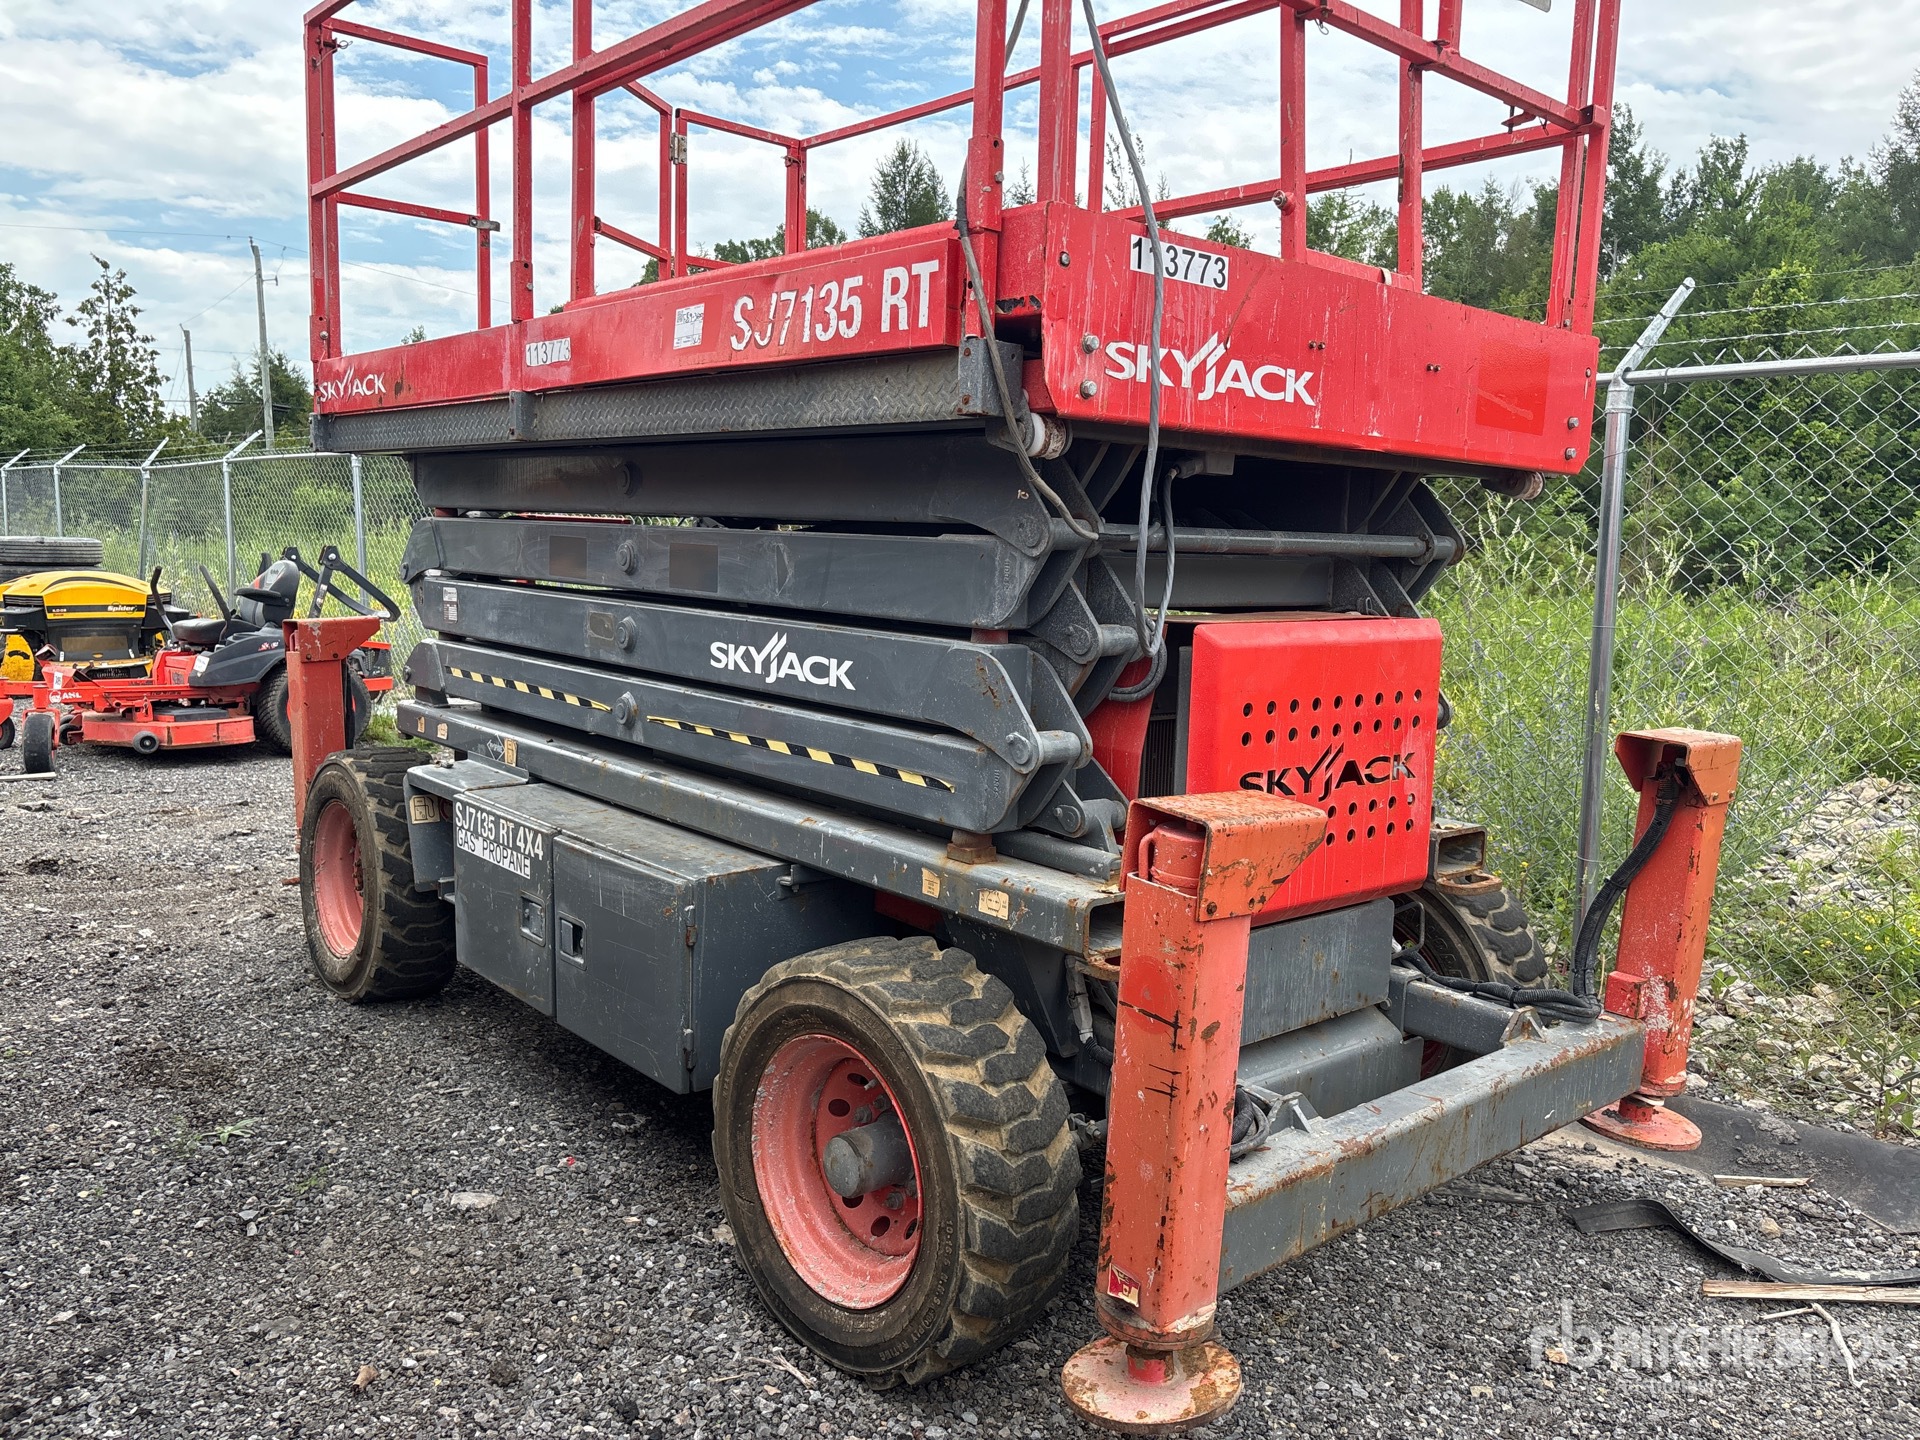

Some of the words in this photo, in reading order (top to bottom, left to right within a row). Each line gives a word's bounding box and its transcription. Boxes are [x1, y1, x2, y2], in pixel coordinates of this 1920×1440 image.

[1132, 237, 1226, 288] 13773
[730, 274, 864, 351] SJ7135
[880, 259, 939, 333] RT
[319, 363, 387, 403] SKYJACK
[526, 340, 572, 367] 113773
[1104, 331, 1316, 407] SKYJACK
[710, 631, 857, 691] SKYJACK
[1239, 742, 1417, 802] SKYJACK
[455, 801, 496, 840] SJ7135
[500, 818, 515, 848] RT
[516, 826, 544, 861] 4X4
[457, 828, 476, 853] GAS
[482, 838, 531, 877] PROPANE
